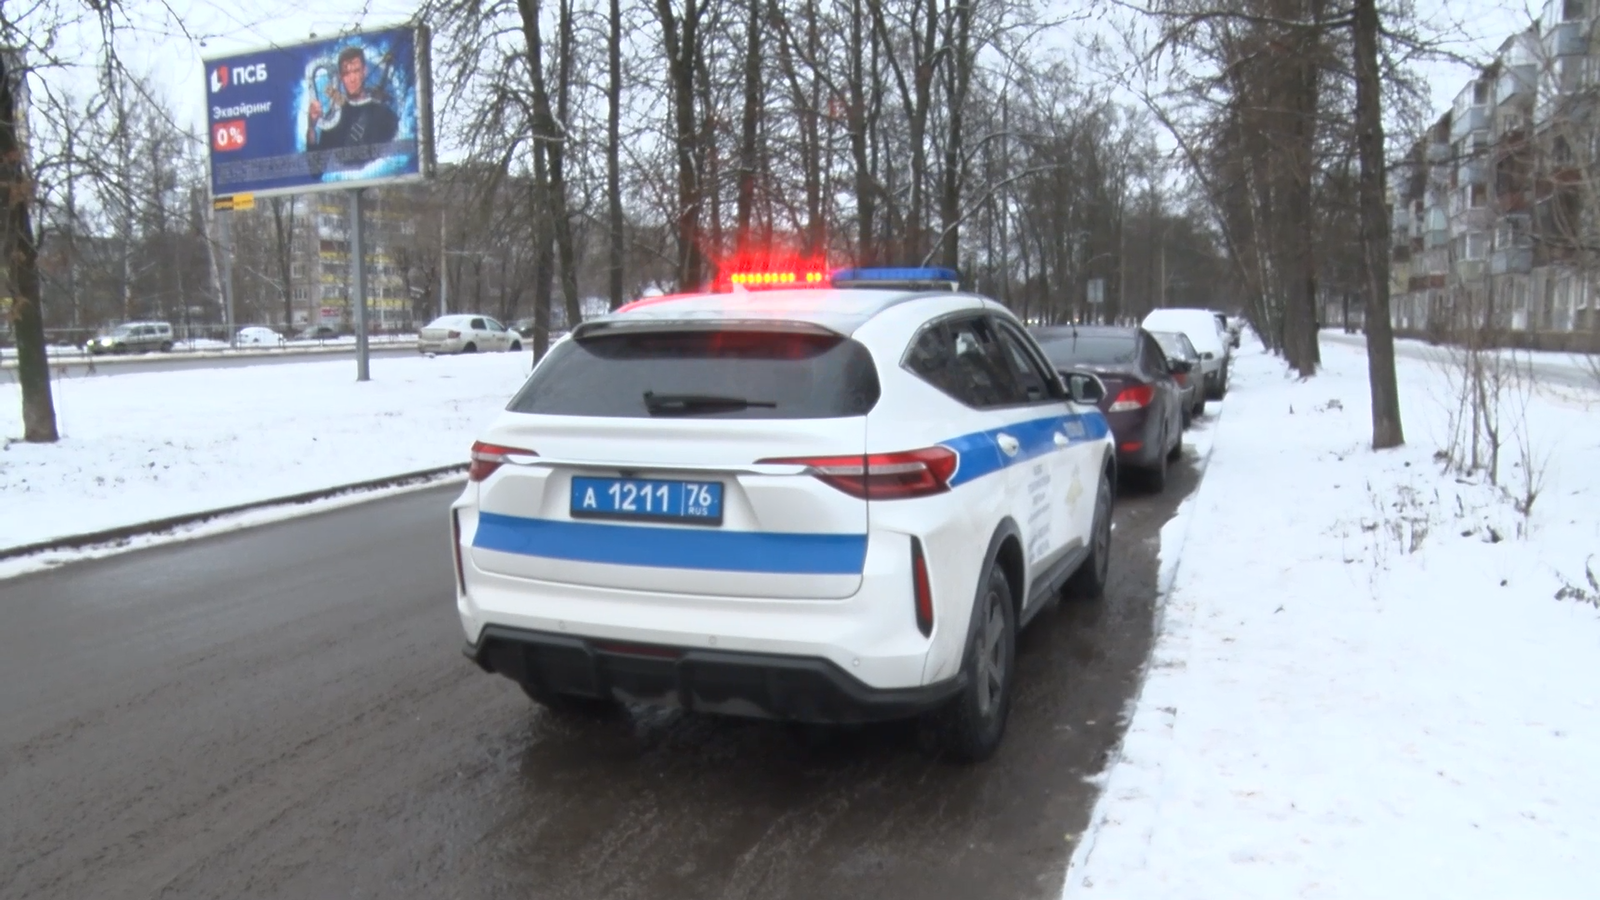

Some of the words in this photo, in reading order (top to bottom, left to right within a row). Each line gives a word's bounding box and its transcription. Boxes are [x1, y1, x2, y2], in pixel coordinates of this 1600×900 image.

[232, 63, 268, 86] ПСБ
[212, 101, 272, 119] Эквайринг
[217, 126, 244, 147] 0%
[608, 482, 669, 512] 1211
[687, 484, 712, 507] 76
[688, 507, 708, 516] RUS
